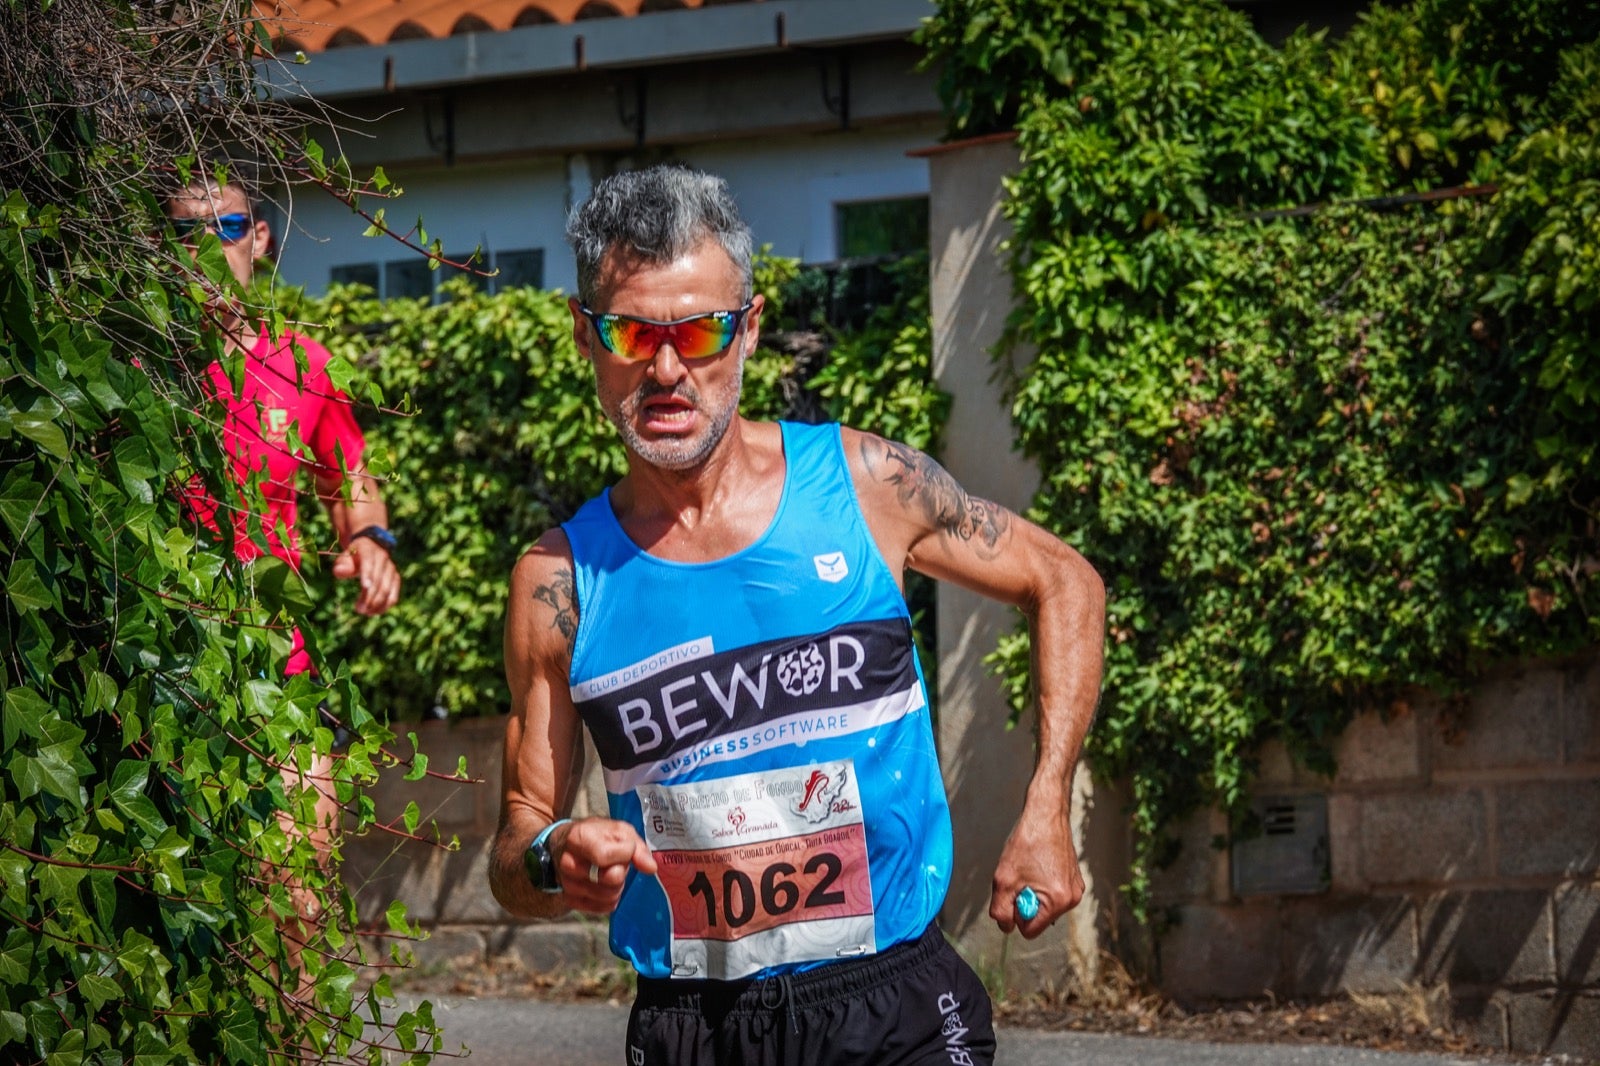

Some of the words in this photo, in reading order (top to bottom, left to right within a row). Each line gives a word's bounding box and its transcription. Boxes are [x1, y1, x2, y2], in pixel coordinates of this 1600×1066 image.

[589, 676, 619, 694] CLUB
[623, 644, 701, 682] DEPORTIVO
[711, 827, 734, 839] Sabor
[740, 820, 779, 835] Granada
[687, 852, 846, 929] 1062
